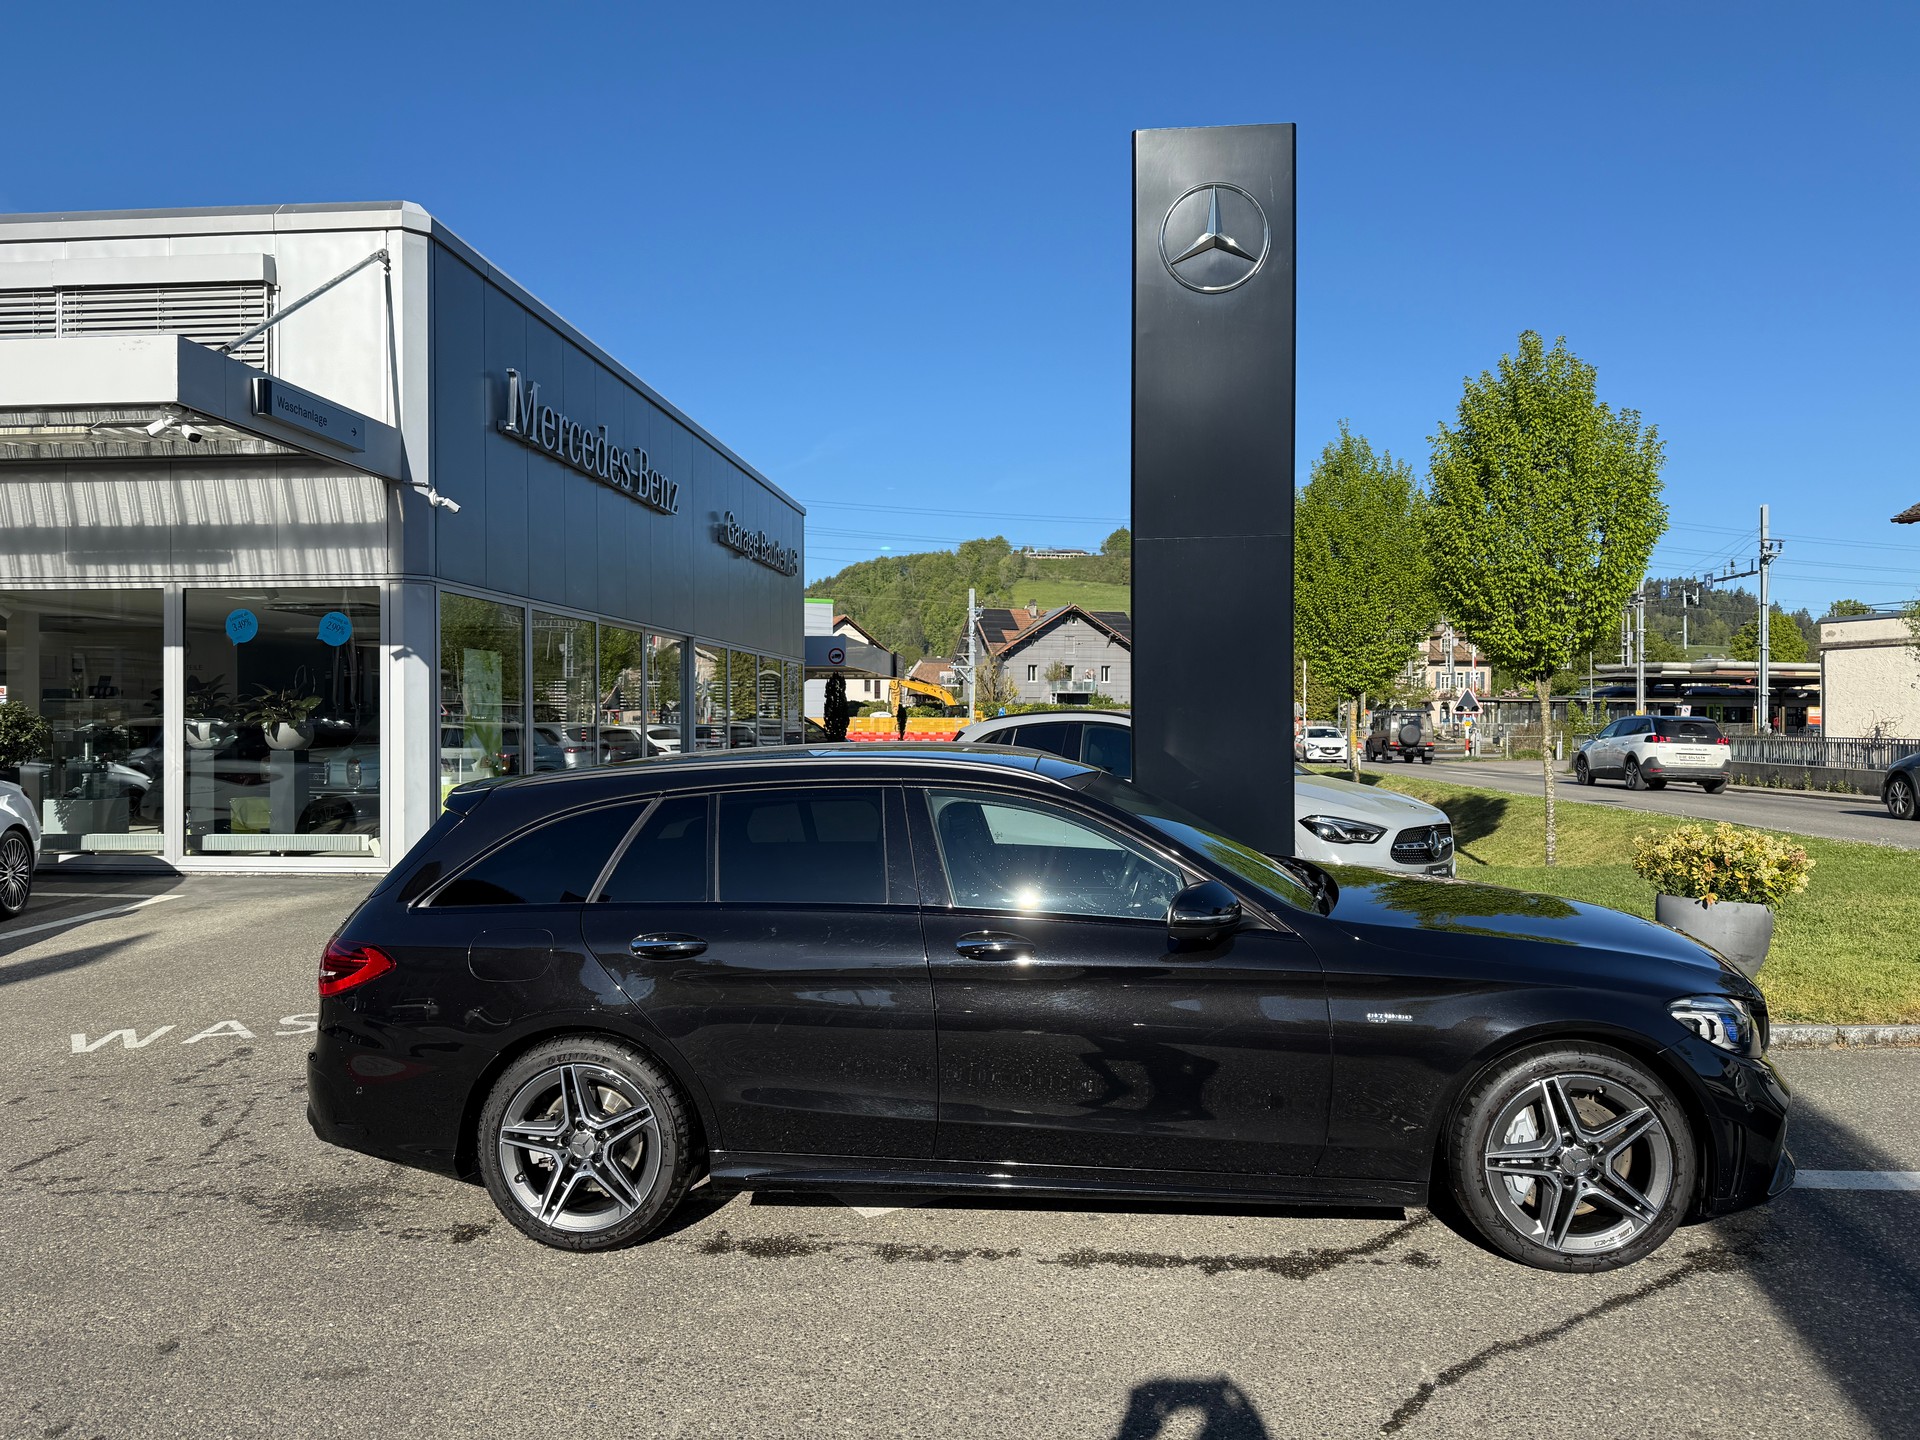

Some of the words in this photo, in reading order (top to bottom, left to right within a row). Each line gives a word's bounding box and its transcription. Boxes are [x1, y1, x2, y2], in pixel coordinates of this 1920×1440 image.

[276, 395, 328, 428] Waschanlage
[505, 367, 680, 515] Mercedes-Benz
[725, 510, 759, 560] Garage
